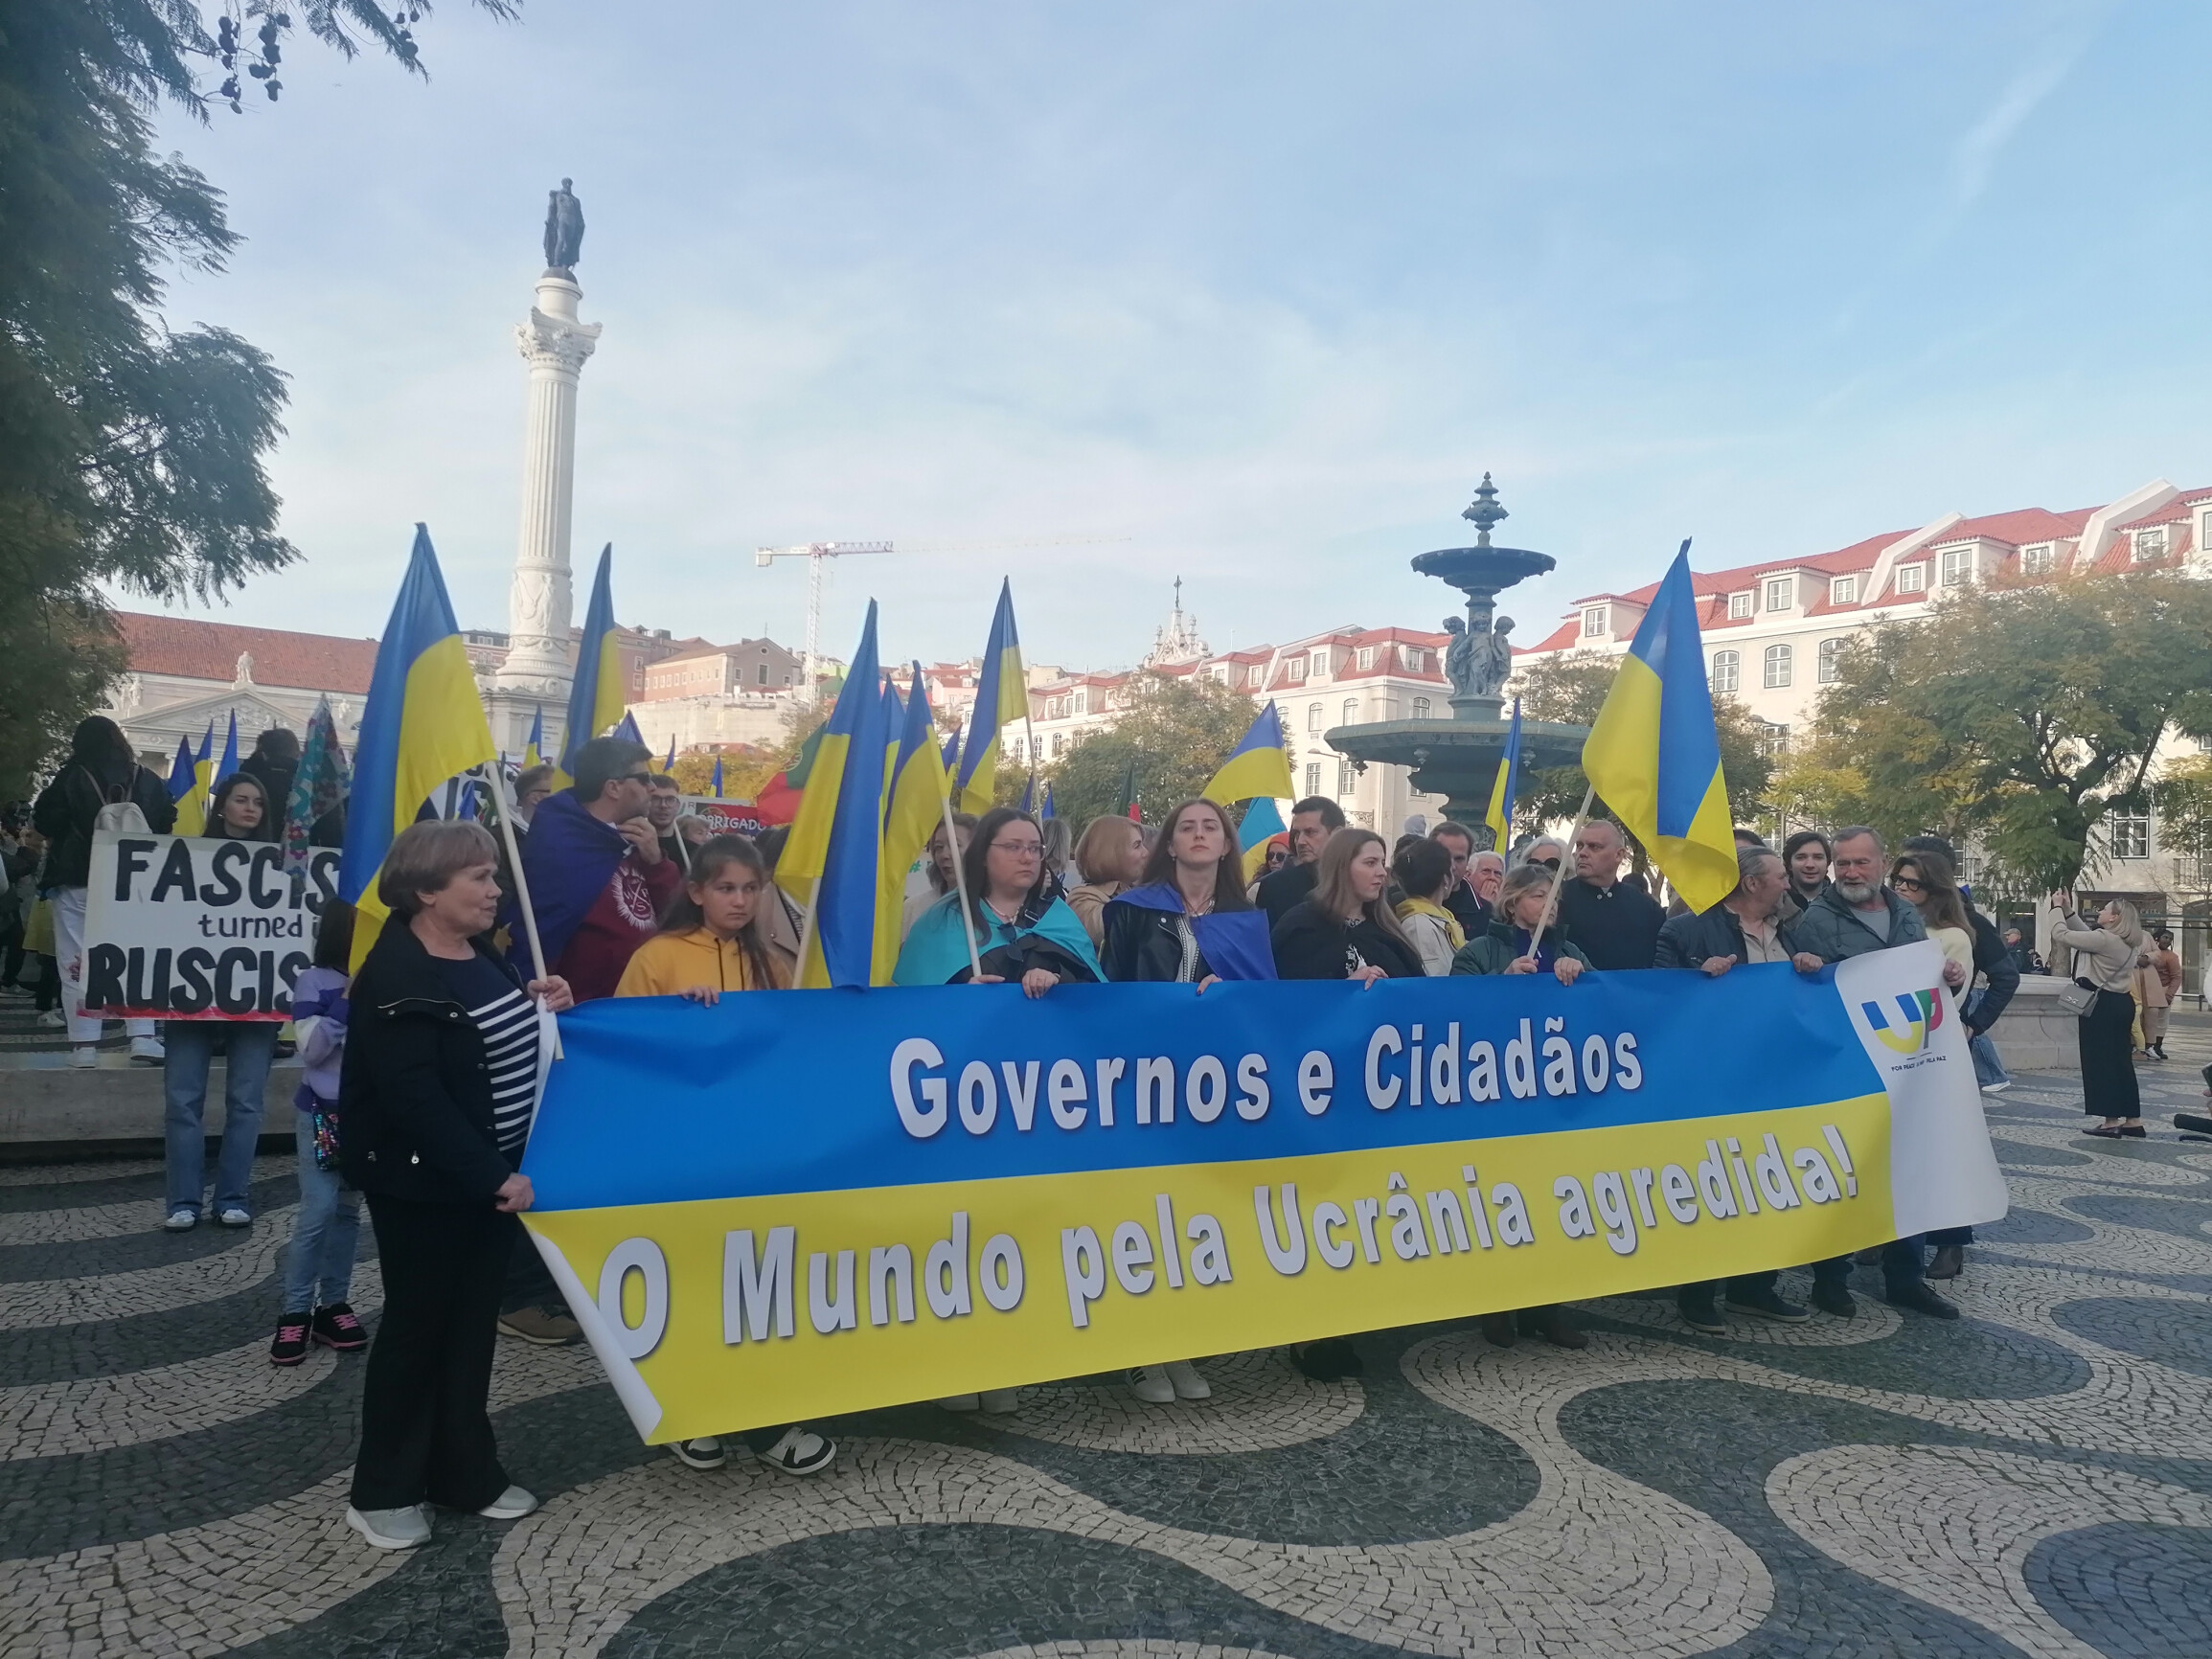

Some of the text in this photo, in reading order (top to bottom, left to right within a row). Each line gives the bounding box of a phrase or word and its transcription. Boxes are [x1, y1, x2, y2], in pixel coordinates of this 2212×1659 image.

[198, 913, 302, 939] turned
[890, 1016, 1642, 1138] Governos e Cidadãos
[598, 1125, 1858, 1359] O Mundo pela Ucrânia agredida!
